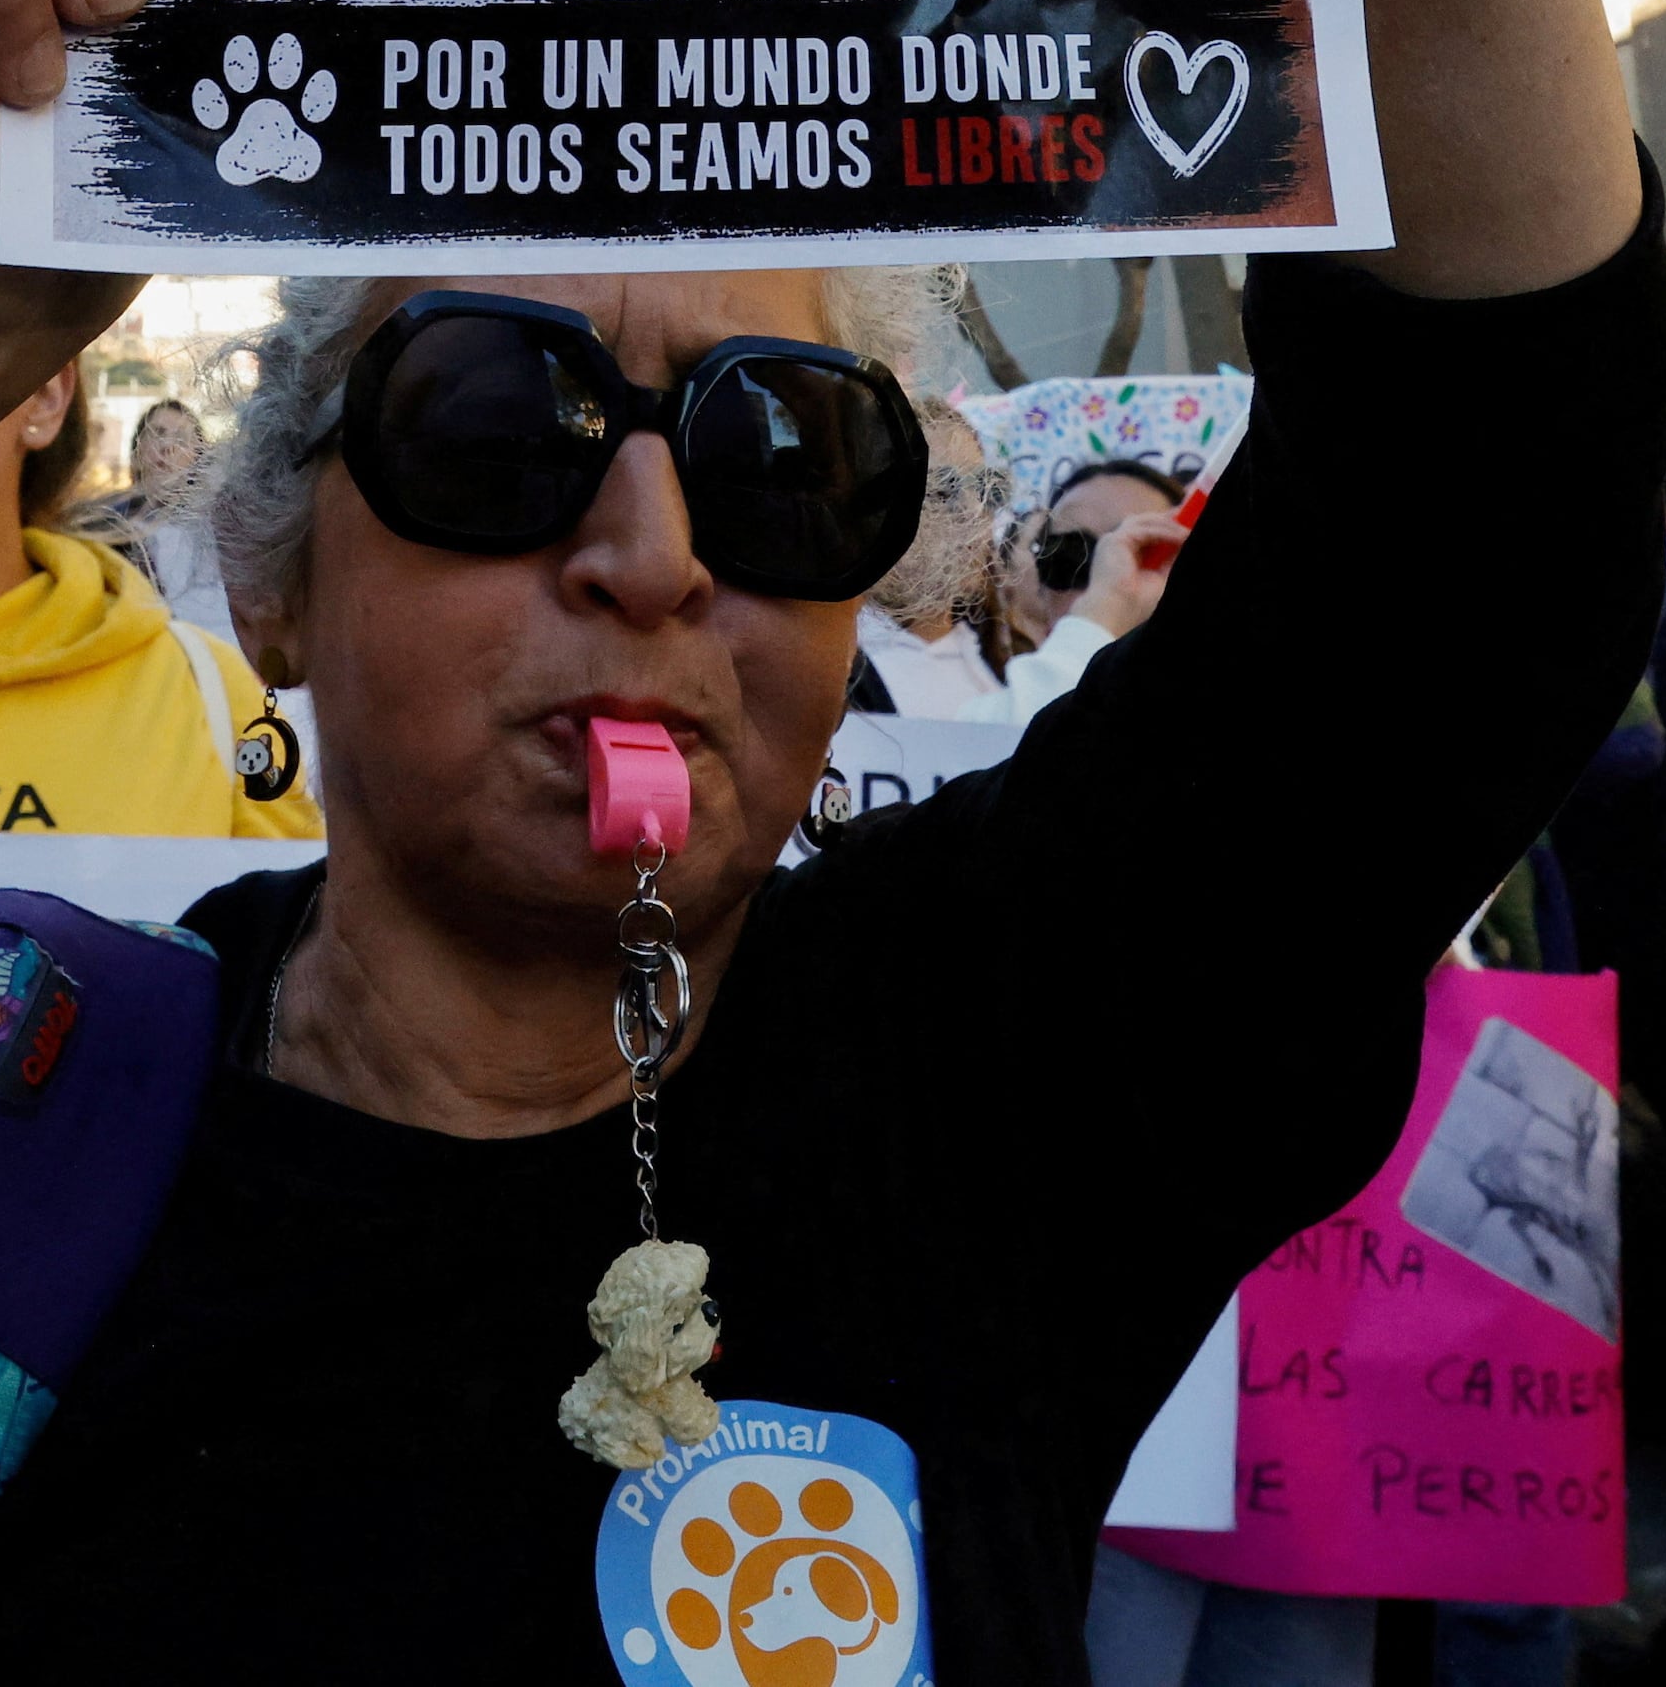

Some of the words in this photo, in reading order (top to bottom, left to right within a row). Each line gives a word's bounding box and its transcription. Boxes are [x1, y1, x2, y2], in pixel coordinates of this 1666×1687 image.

[383, 37, 508, 110] POR
[542, 38, 624, 110] UN
[656, 35, 872, 109] MUNDO
[900, 31, 1097, 104] DONDE
[379, 122, 584, 196] TODOS
[616, 117, 872, 194] SEAMOS
[901, 112, 1106, 188] LIBRES
[1239, 1323, 1349, 1400] LAS
[1359, 1444, 1614, 1524] PERROS
